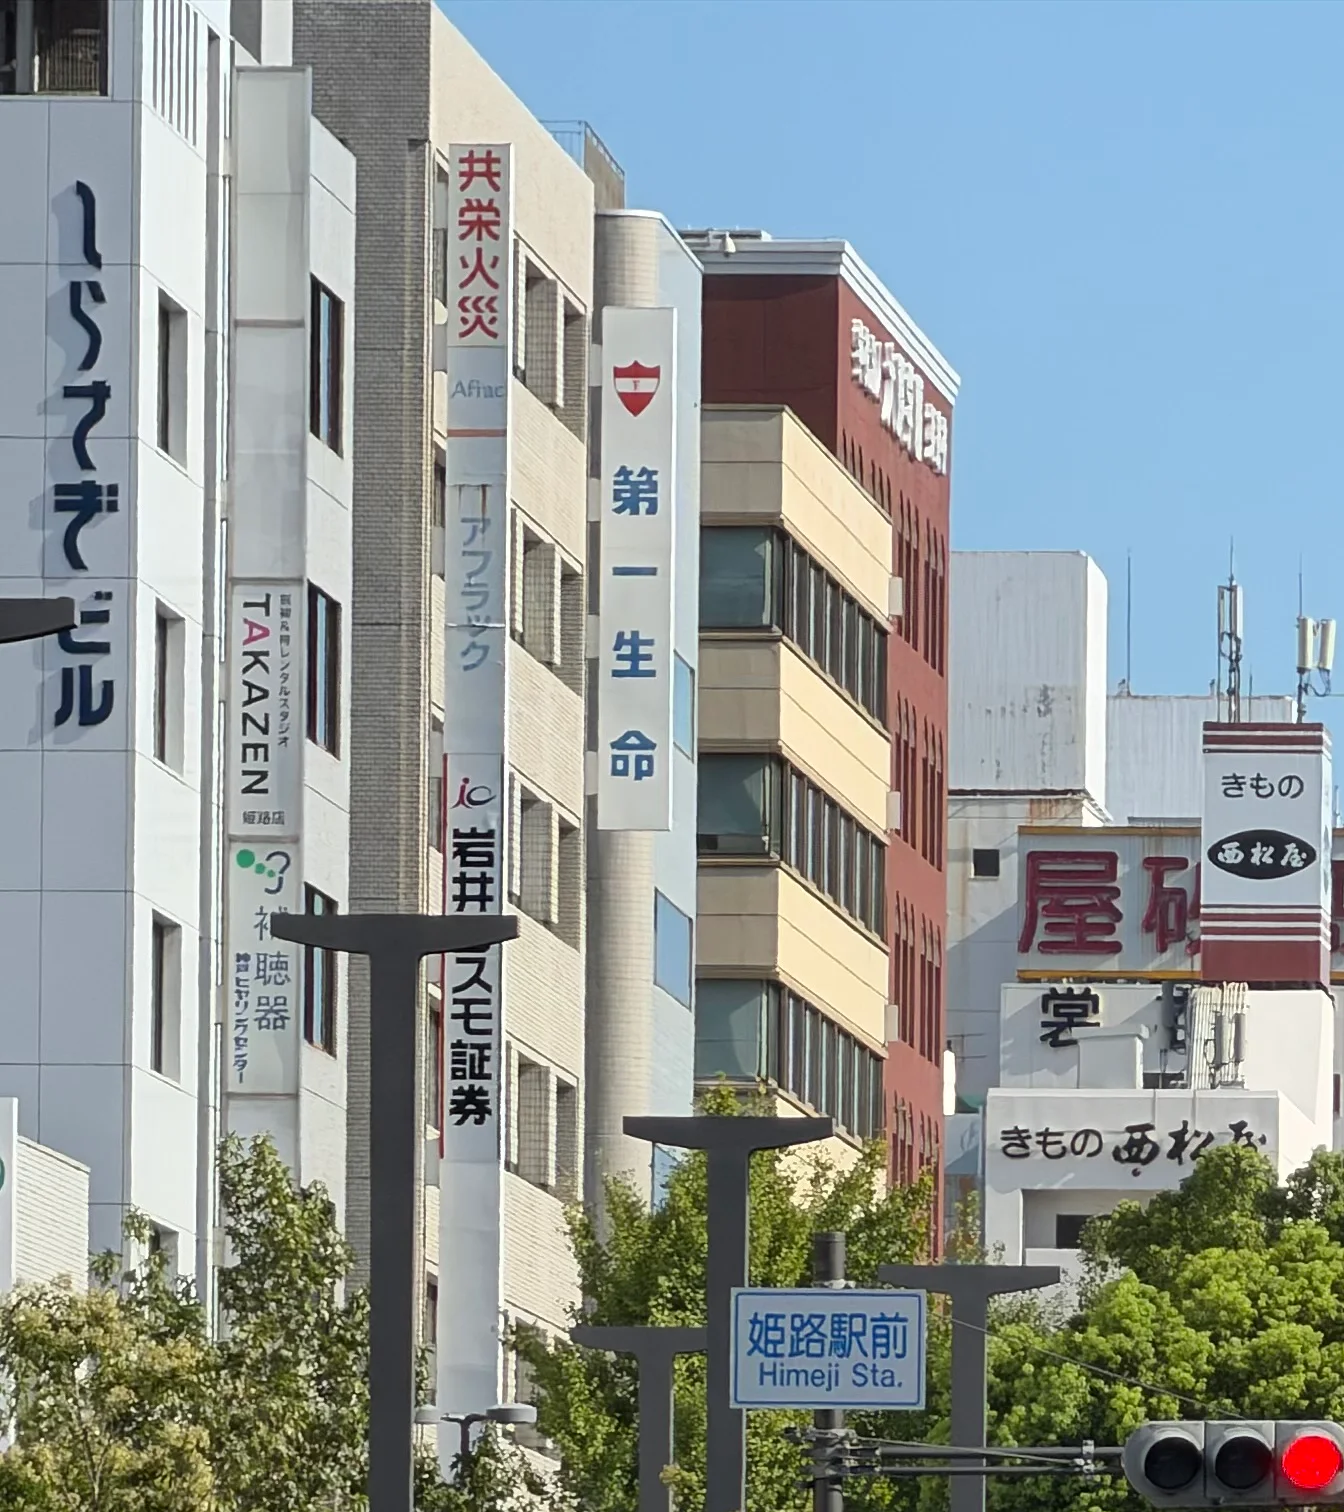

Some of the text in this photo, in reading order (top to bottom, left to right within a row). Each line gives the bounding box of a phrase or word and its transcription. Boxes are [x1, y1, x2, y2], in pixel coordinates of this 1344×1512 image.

[458, 149, 502, 340] 共栄火災
[461, 516, 492, 673] アフラック
[609, 464, 659, 784] 第一生命
[242, 592, 271, 795] TAKAZEN
[1221, 773, 1304, 800] きもの
[1217, 841, 1308, 868] 西松屋
[449, 826, 495, 1127] 岩井スモ証券
[1001, 1125, 1103, 1160] きもの
[747, 1312, 909, 1359] 姫路駅前
[758, 1362, 904, 1392] Himeji Sta.
